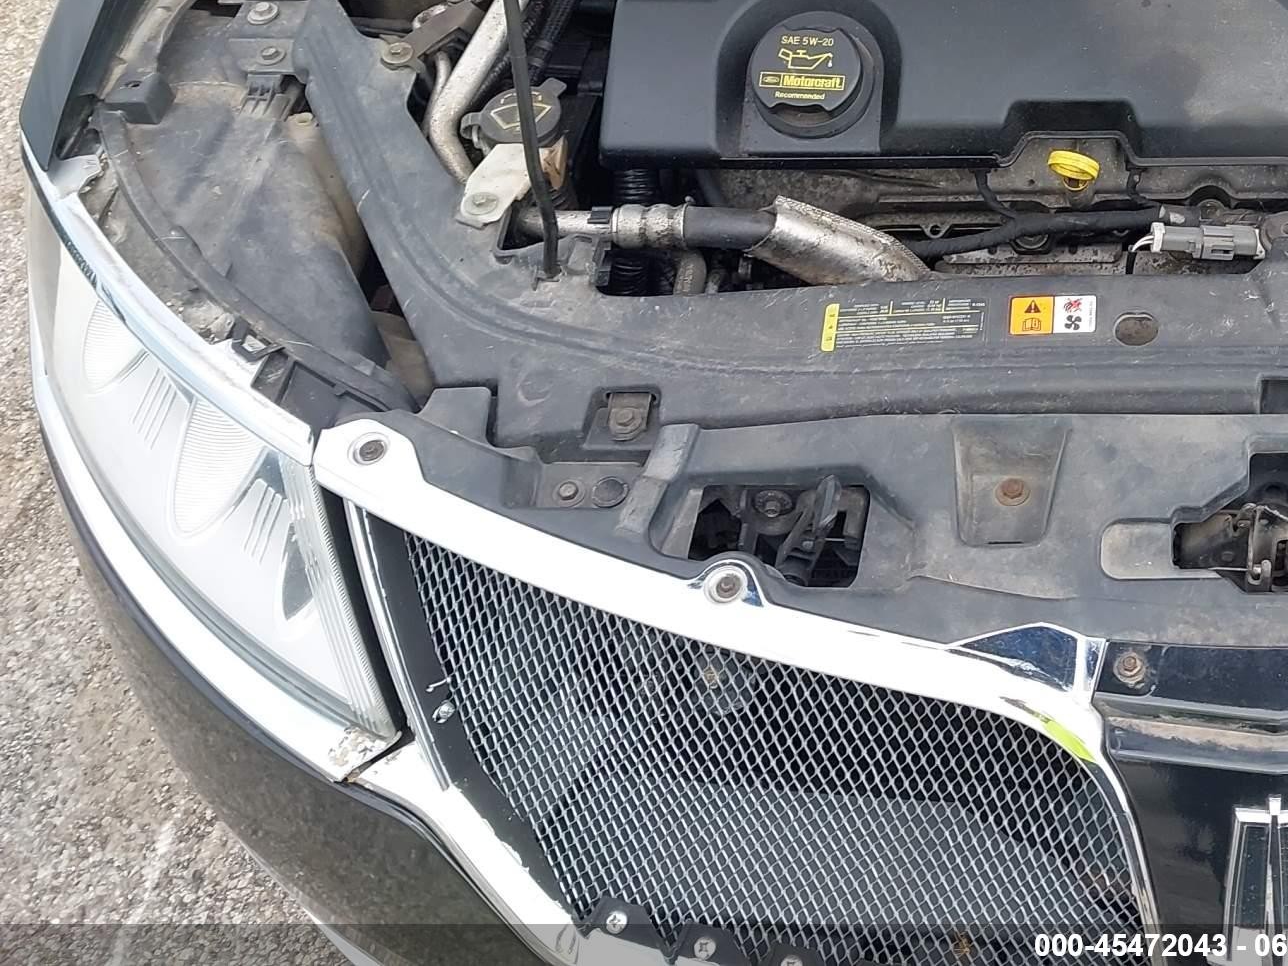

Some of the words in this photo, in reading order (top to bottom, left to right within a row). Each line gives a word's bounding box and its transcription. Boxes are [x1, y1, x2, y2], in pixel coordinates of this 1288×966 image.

[781, 35, 800, 44] SAE
[802, 36, 834, 46] 5W-20
[783, 75, 842, 88] Motorcraft
[775, 91, 825, 100] Recommended
